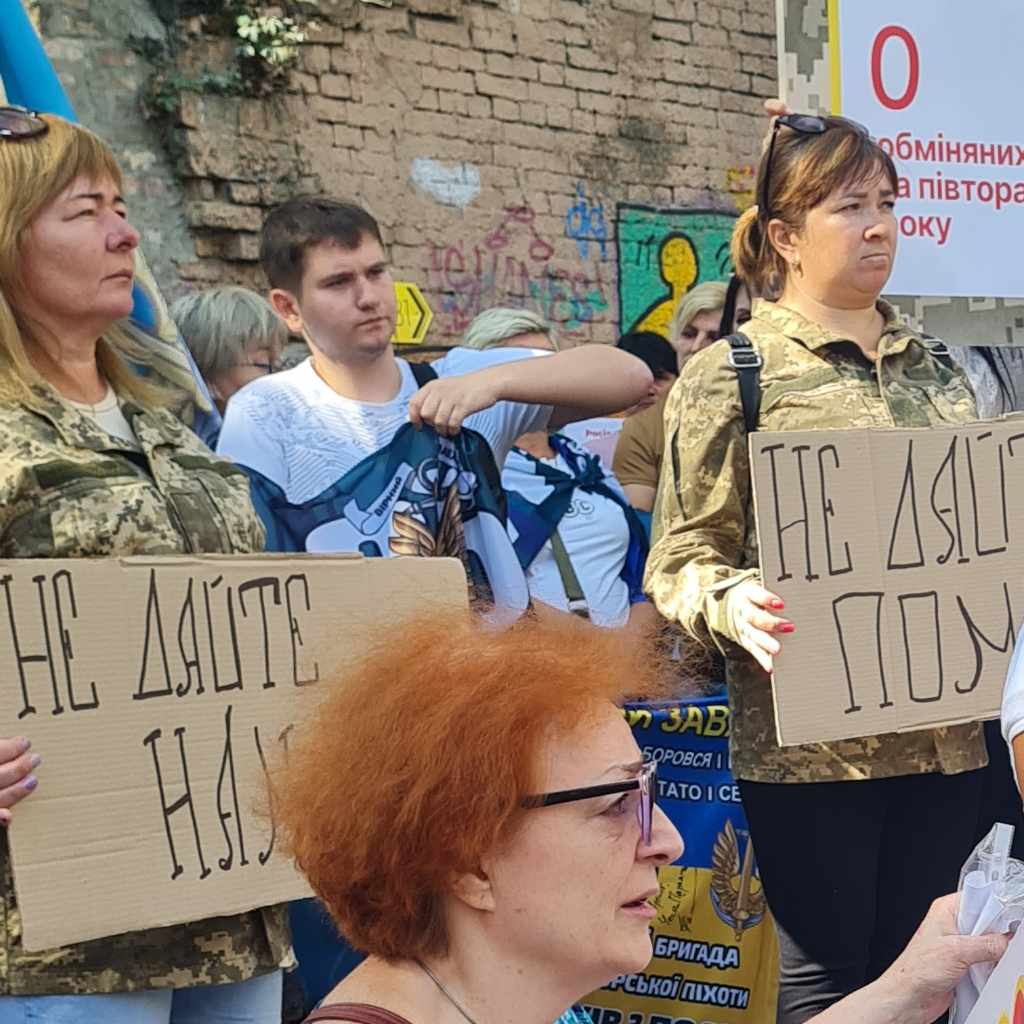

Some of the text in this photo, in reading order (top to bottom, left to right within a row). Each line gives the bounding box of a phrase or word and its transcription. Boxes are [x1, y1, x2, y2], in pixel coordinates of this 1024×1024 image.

[761, 444, 852, 582] НЕ
[0, 568, 320, 720] НЕ ДАЙТЕ
[657, 781, 702, 800] ТАТО
[655, 938, 738, 967] БРИГАДА
[681, 982, 748, 1007] ПІХОТИ
